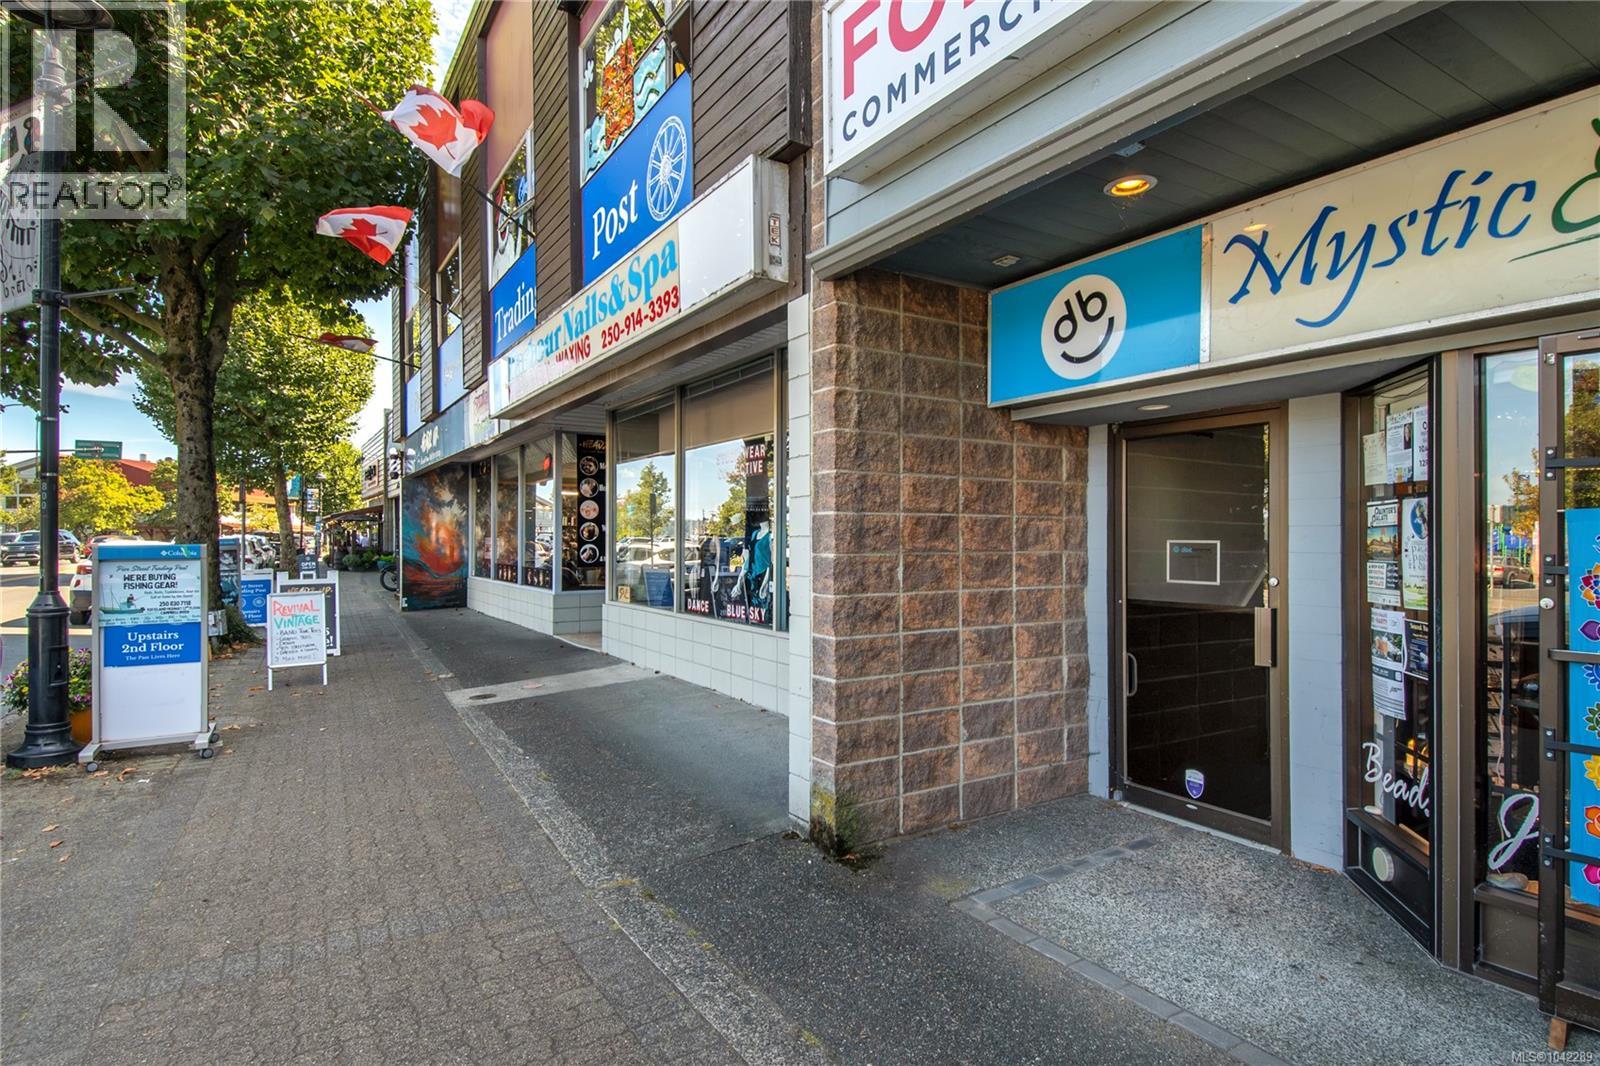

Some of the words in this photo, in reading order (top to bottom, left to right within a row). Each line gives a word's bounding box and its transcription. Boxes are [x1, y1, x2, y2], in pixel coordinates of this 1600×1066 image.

[843, 0, 984, 100] FO
[592, 179, 638, 260] Post
[1223, 169, 1537, 328] Mystic
[601, 285, 680, 350] 250-914-3393
[1053, 289, 1108, 344] db
[167, 549, 197, 557] Coluia
[148, 573, 176, 581] BUYING
[123, 581, 154, 590] FISHING
[154, 581, 178, 590] GEAR!
[272, 600, 321, 616] REVIVAL
[687, 598, 710, 613] DANCE
[726, 604, 746, 619] BLUE
[749, 605, 767, 621] SKY
[273, 614, 320, 629] VINTAGE
[128, 630, 179, 643] Upstairs
[121, 642, 146, 653] 2nd
[151, 641, 185, 651] Floor
[1362, 742, 1430, 818] Bead
